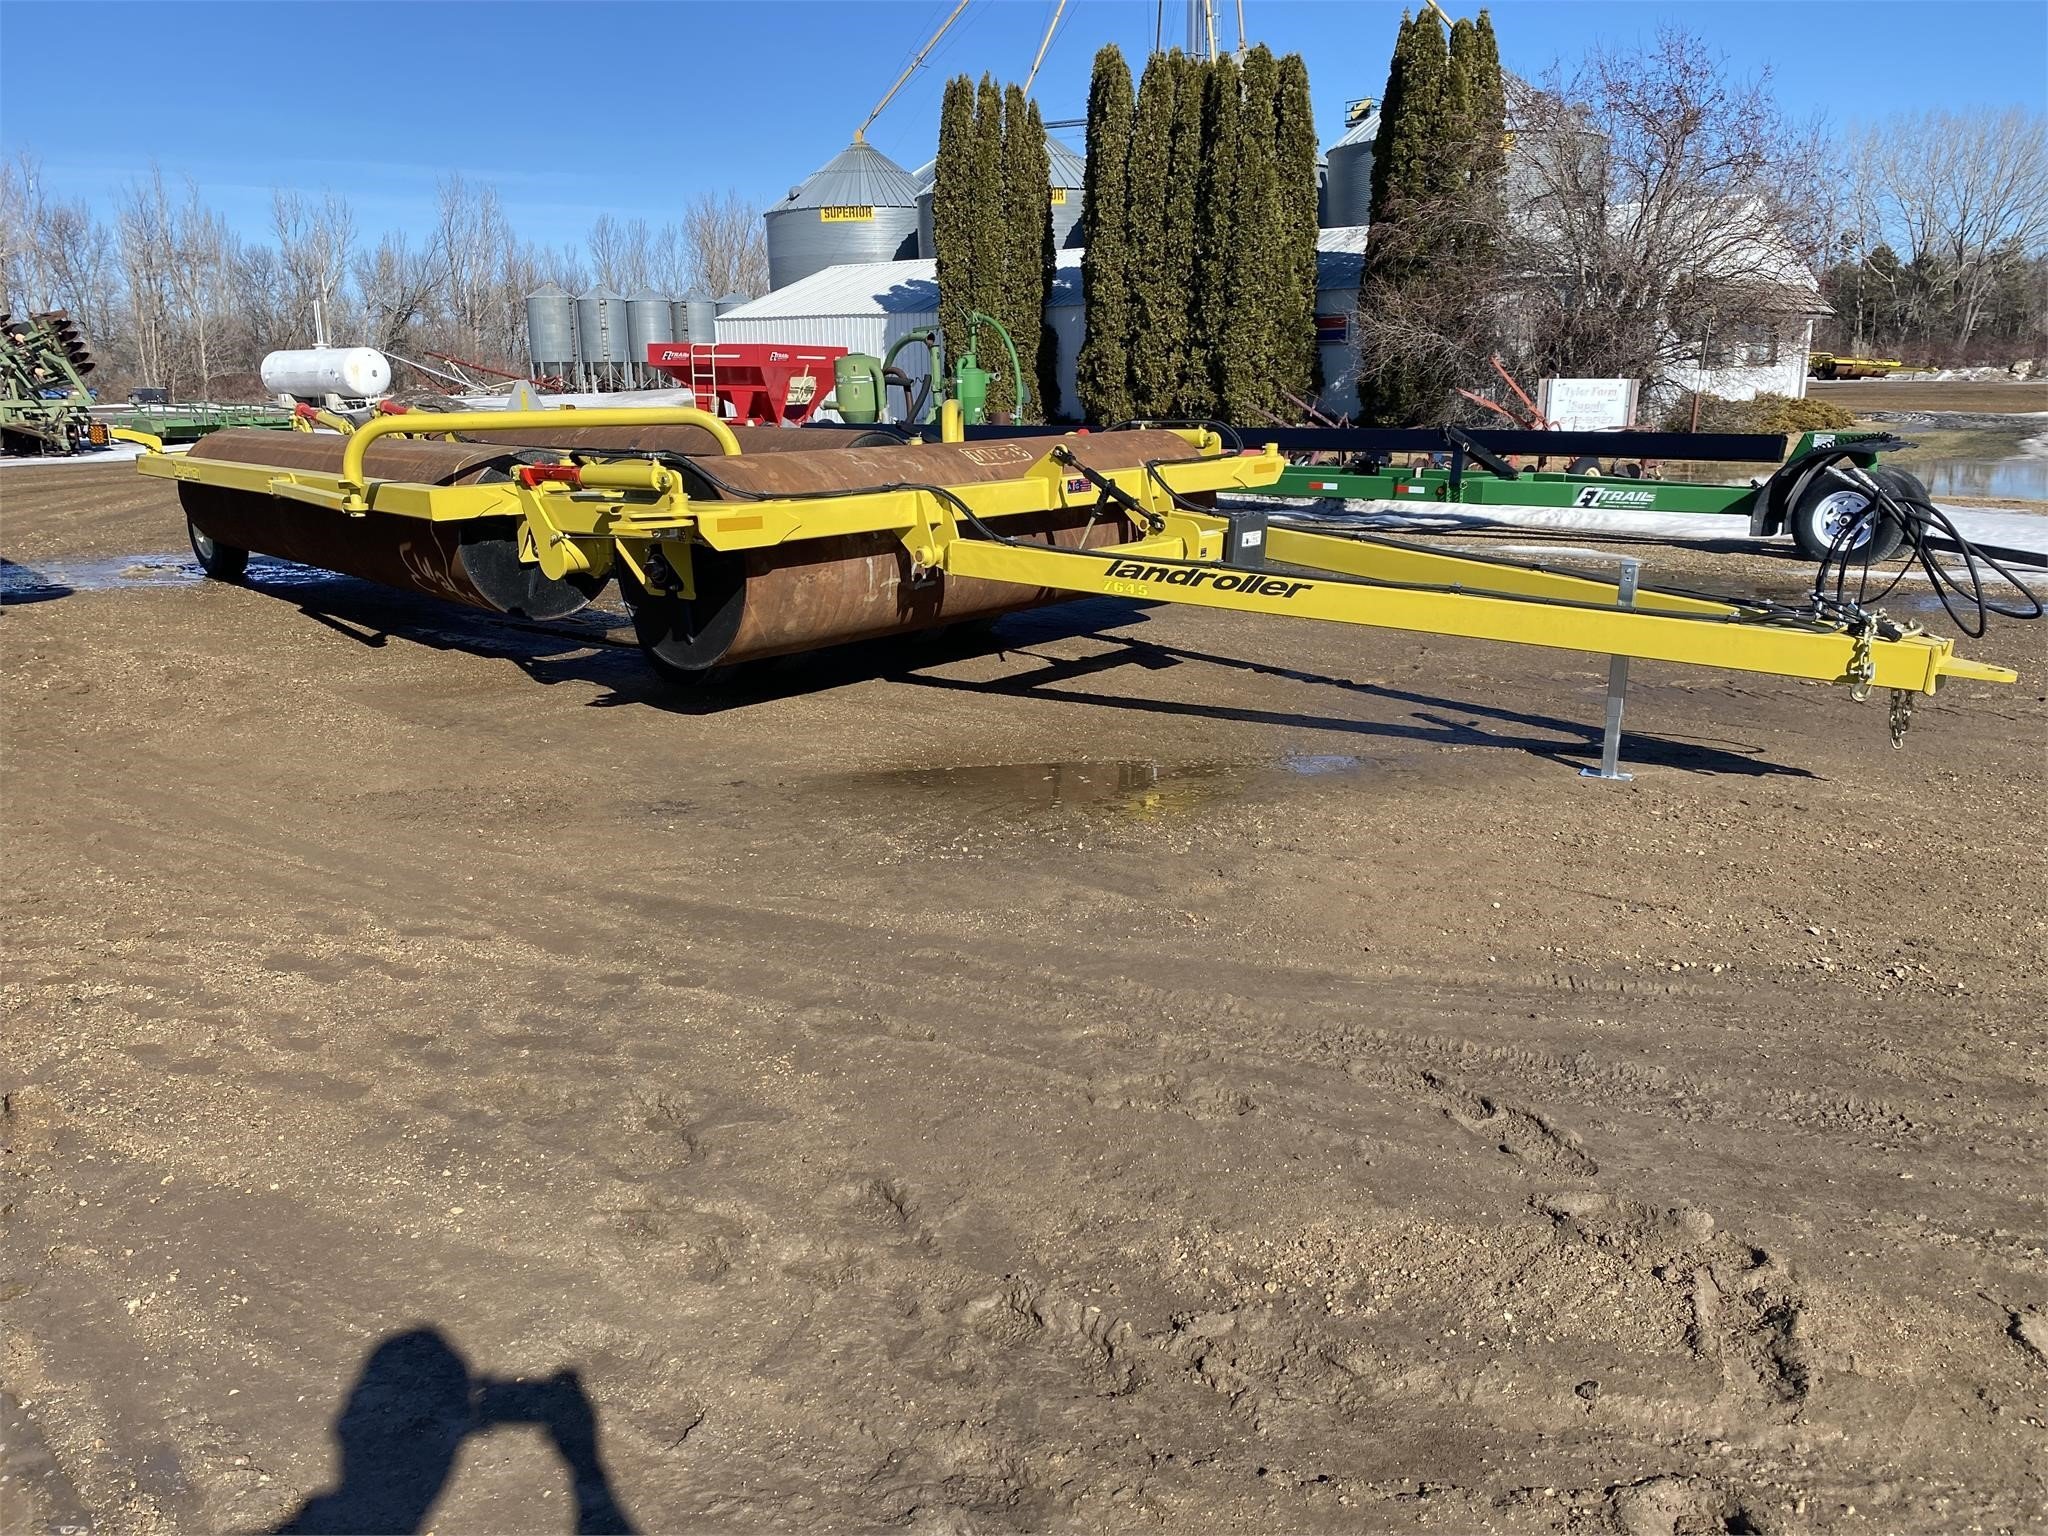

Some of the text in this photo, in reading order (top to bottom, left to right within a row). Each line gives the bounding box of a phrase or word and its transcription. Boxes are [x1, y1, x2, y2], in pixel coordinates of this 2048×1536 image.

[823, 206, 873, 219] SUPERIOR
[1591, 386, 1618, 398] Farm
[1103, 559, 1315, 599] landroller
[1103, 580, 1149, 597] 7645
